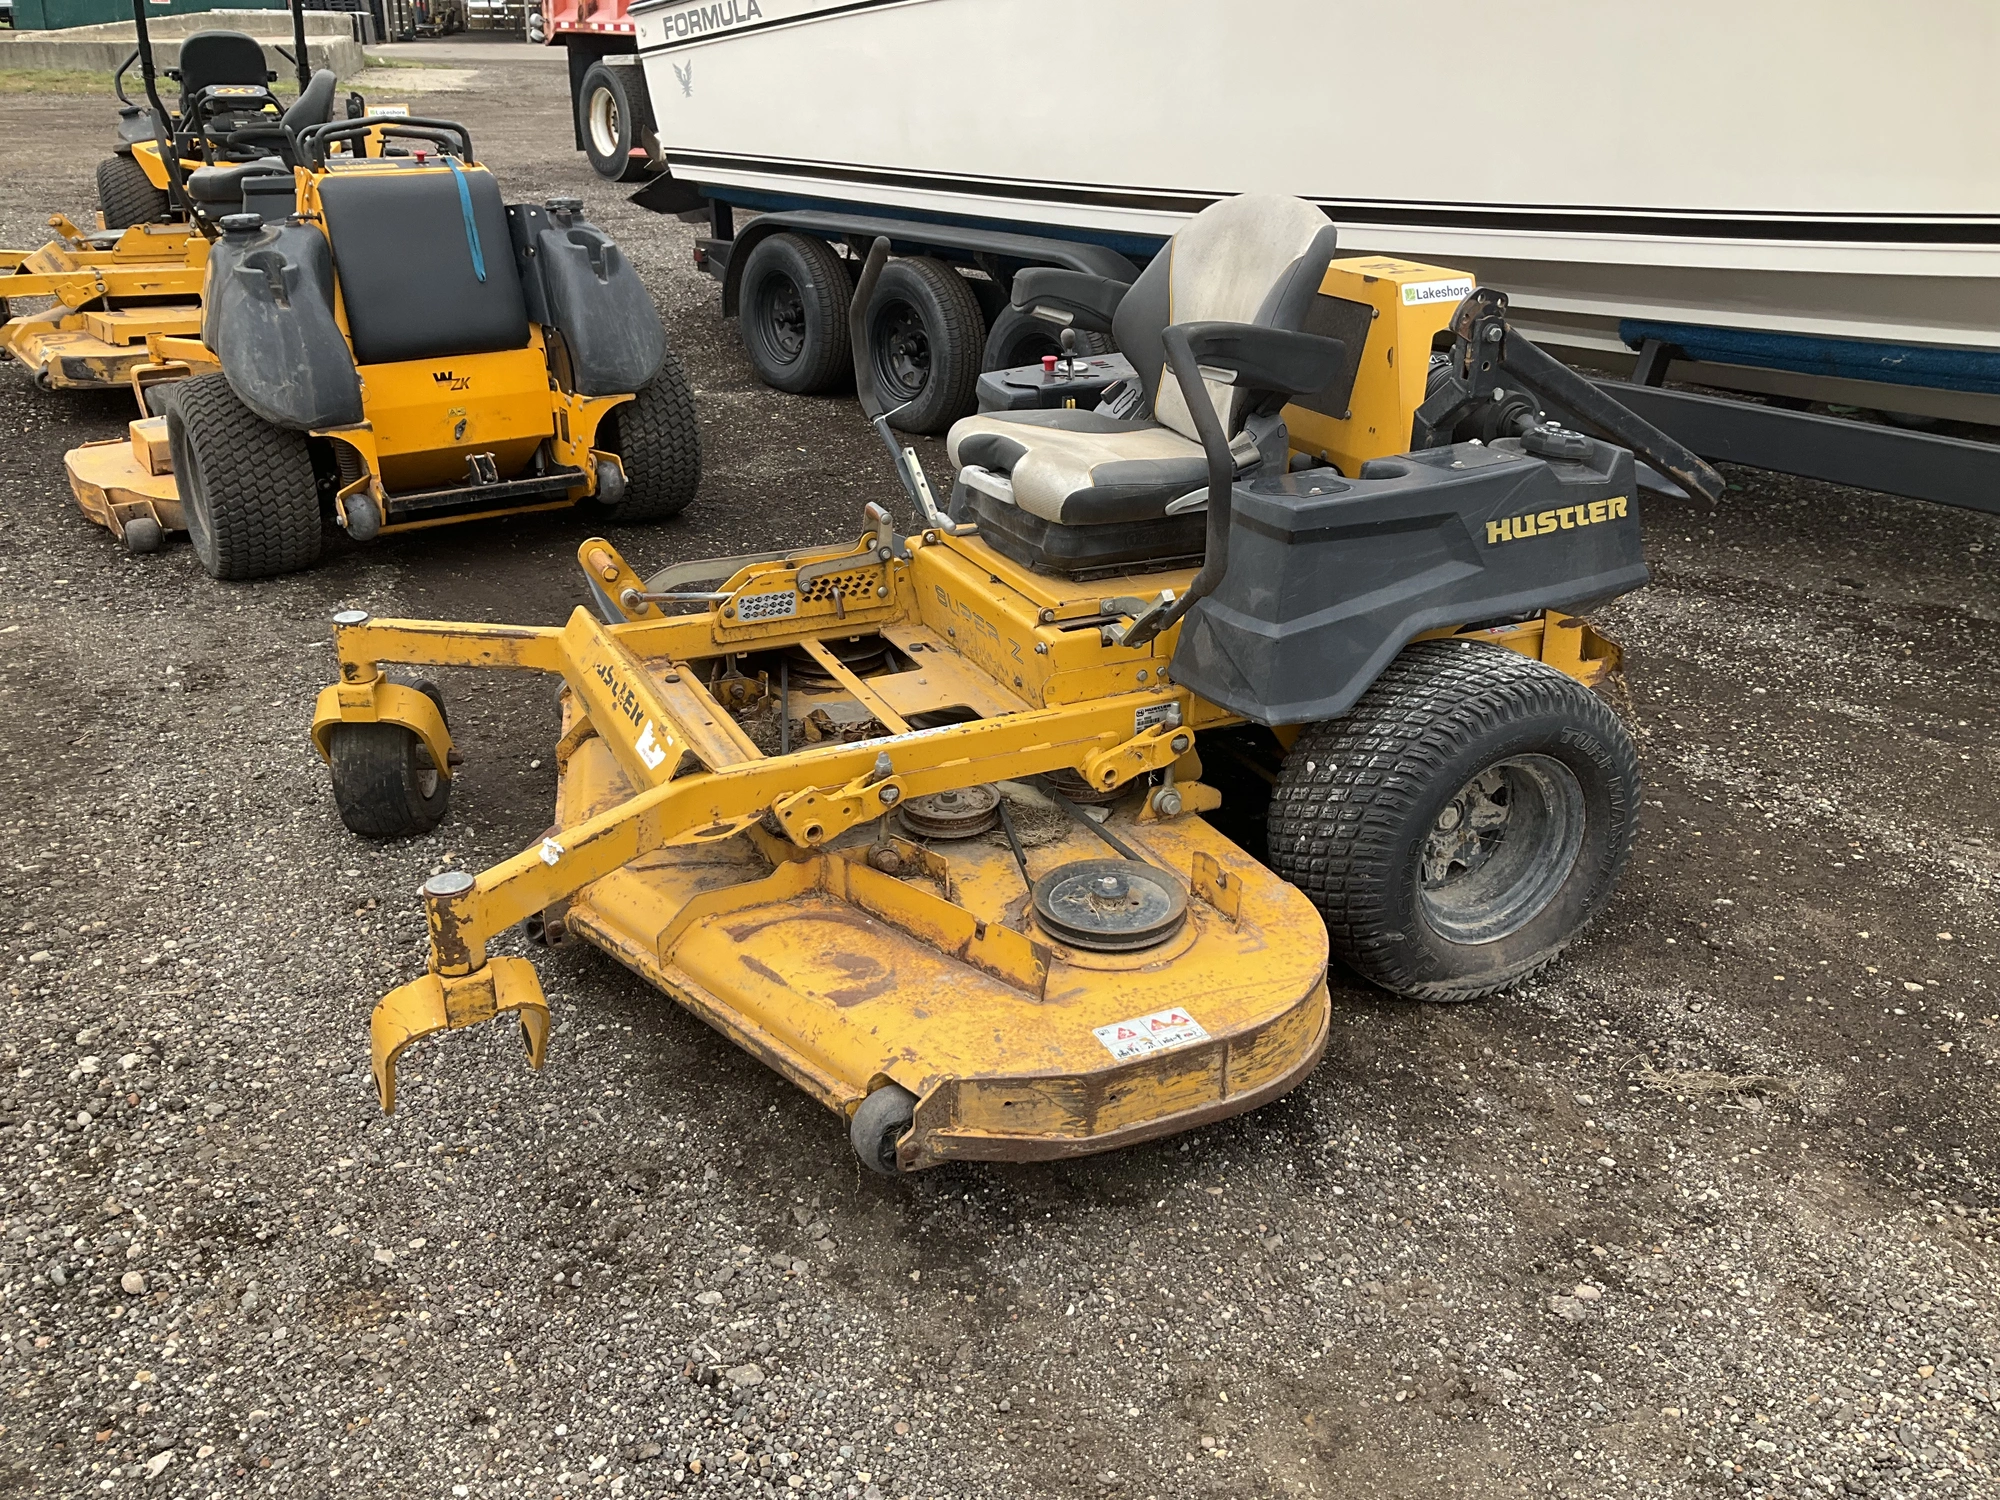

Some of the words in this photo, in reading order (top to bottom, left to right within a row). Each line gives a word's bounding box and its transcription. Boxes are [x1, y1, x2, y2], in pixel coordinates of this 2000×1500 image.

[662, 0, 763, 40] FORMULA
[1416, 285, 1470, 300] Lakeshore
[1485, 496, 1628, 544] HUSTLER
[934, 584, 1001, 648] SUPER
[1008, 637, 1025, 665] Z
[1559, 726, 1618, 771] TURF
